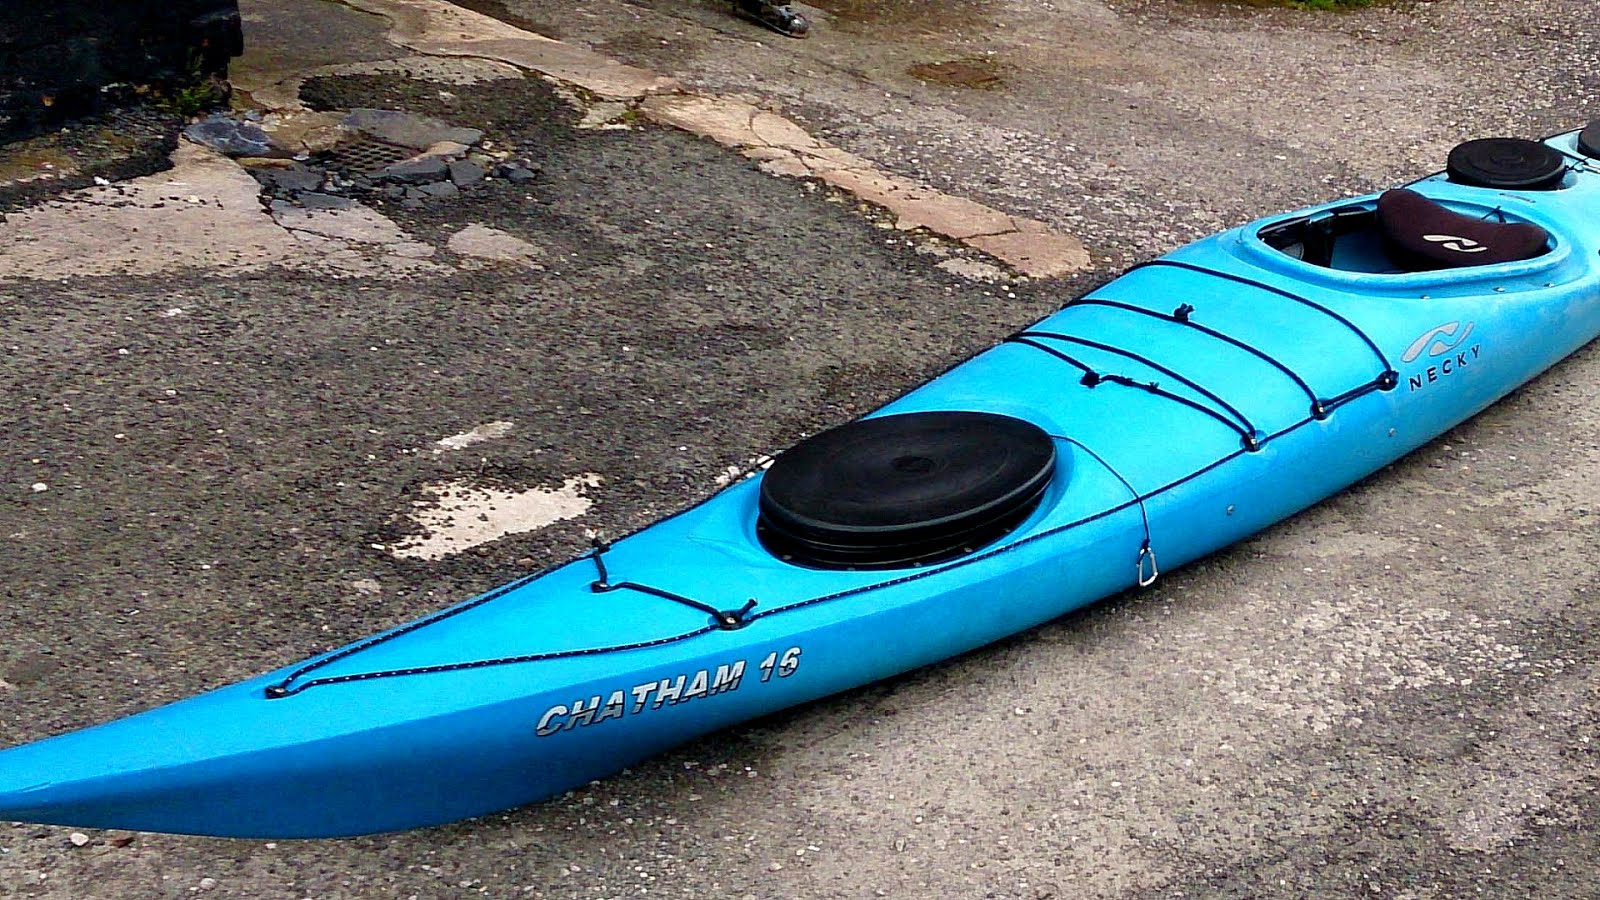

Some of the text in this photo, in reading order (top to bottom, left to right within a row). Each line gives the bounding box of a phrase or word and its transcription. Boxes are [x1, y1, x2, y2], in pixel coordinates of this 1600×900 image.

[1409, 344, 1480, 391] NECKY
[535, 647, 802, 736] CHATHAM 16
